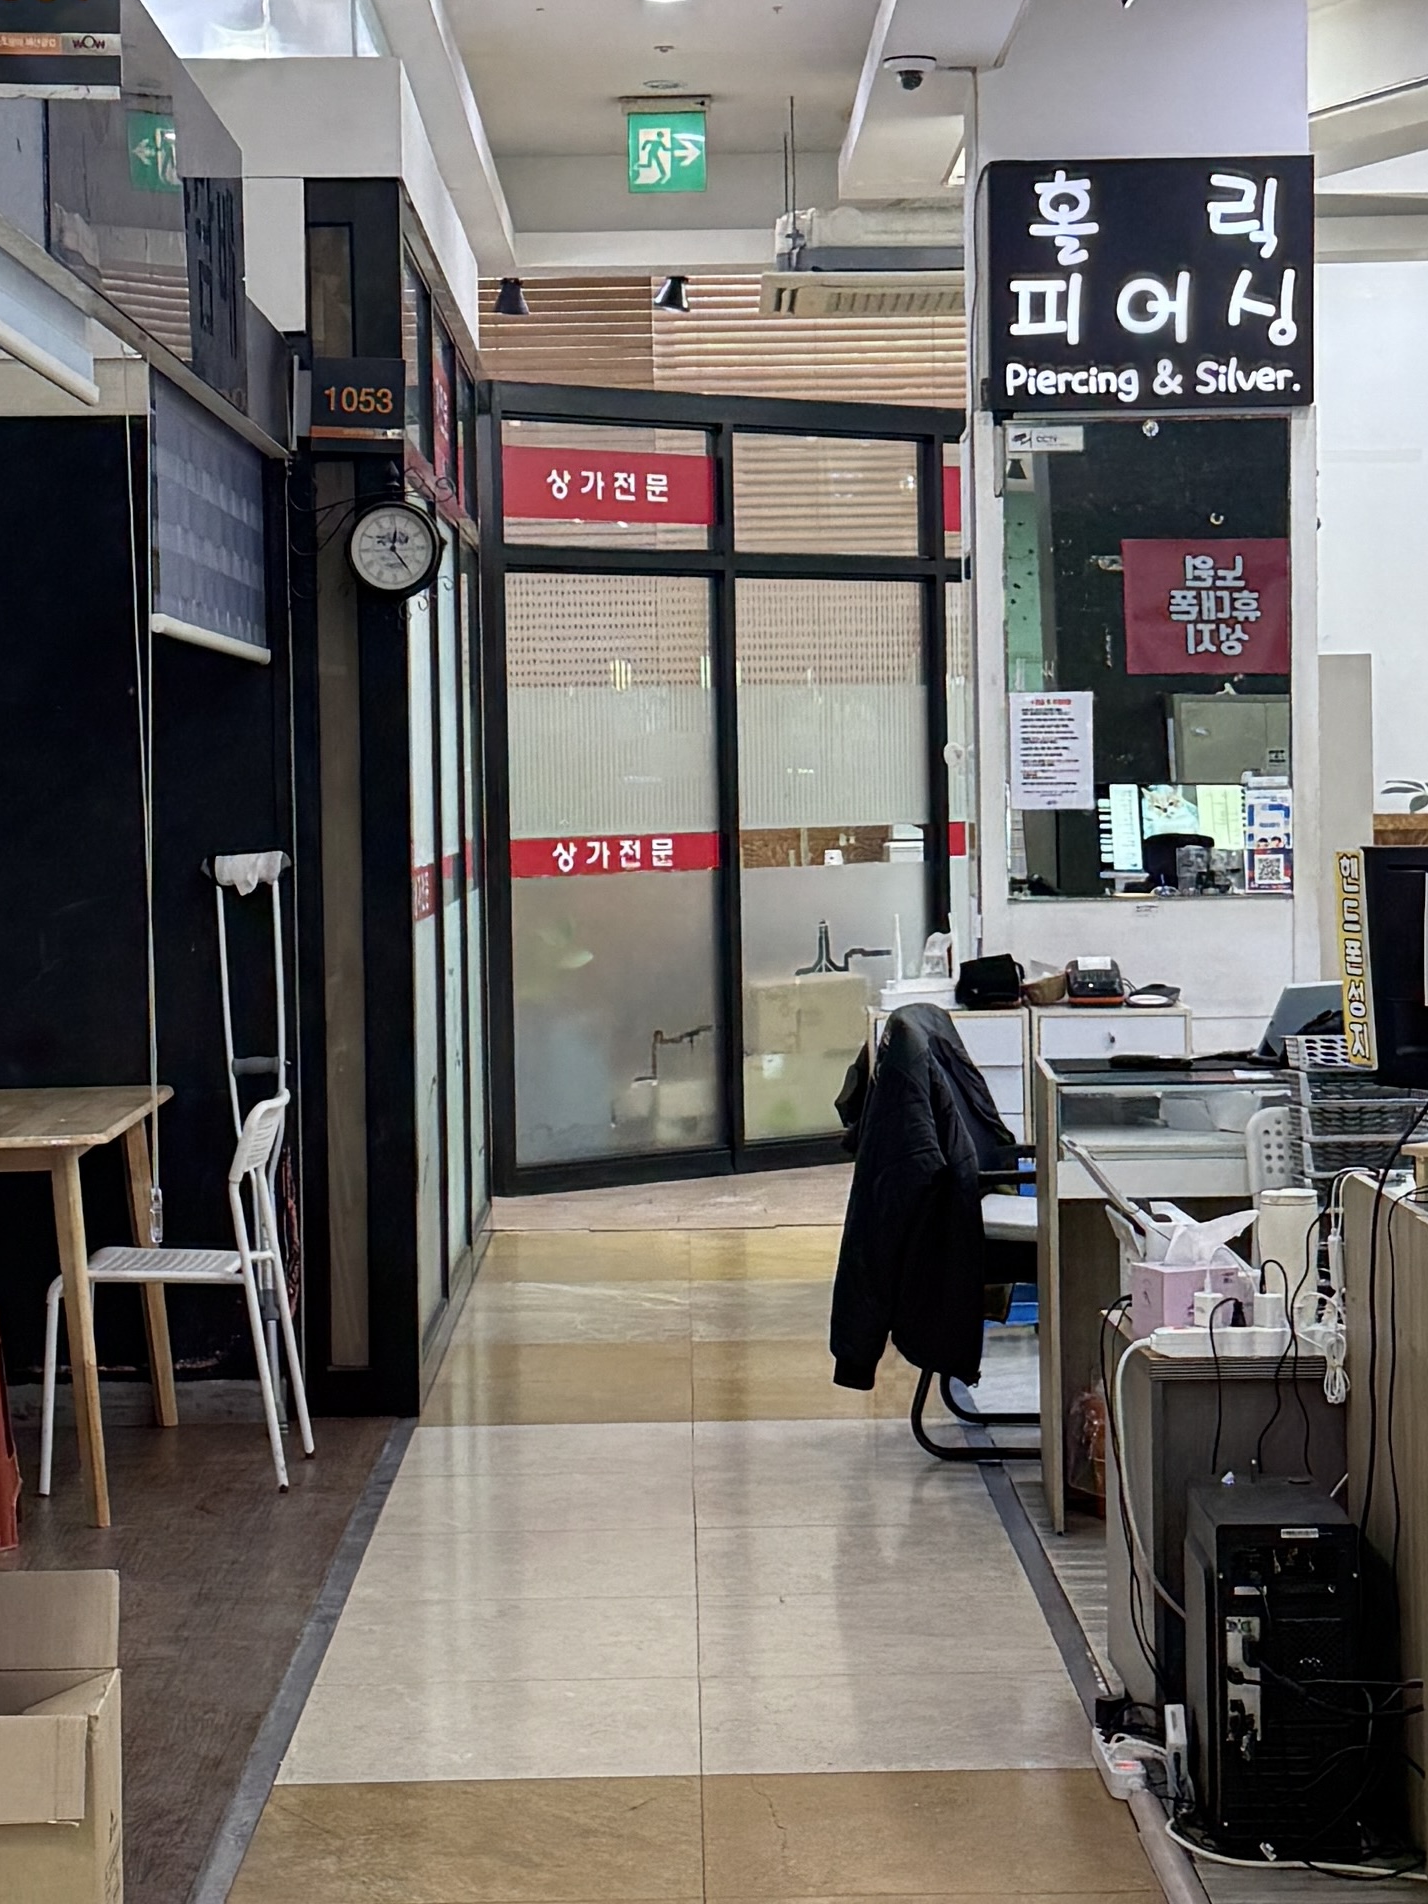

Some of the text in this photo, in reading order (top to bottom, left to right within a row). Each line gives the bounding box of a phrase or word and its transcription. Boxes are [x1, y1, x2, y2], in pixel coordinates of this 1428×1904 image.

[1009, 268, 1298, 347] 피어싱
[1006, 359, 1302, 401] Piercing & Silver.
[324, 385, 394, 414] 1053
[546, 469, 668, 503] 상가전문
[552, 838, 674, 873] 상가전문
